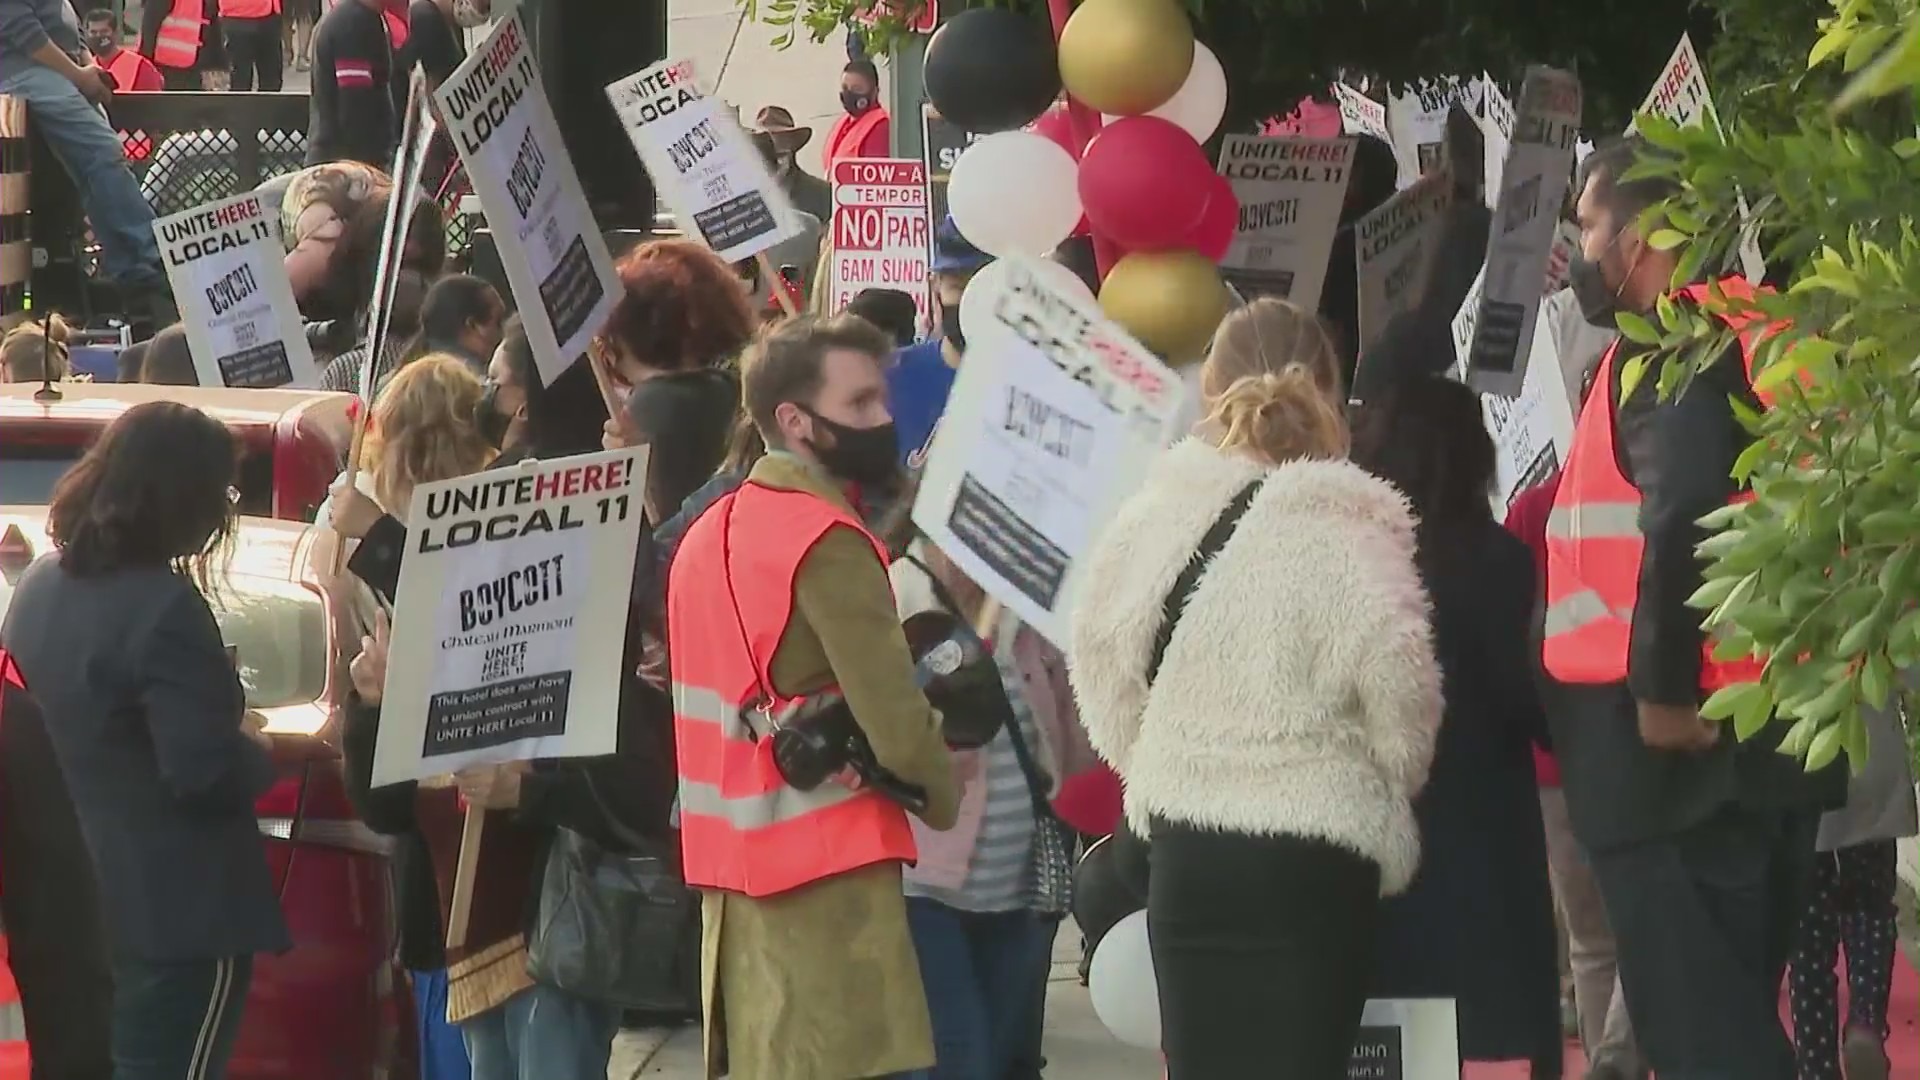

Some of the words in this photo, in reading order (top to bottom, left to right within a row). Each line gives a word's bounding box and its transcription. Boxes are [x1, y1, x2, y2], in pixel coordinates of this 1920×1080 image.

[447, 18, 522, 120] UNITEHERE!
[461, 77, 522, 155] LOCAL
[518, 55, 535, 88] 11
[1687, 75, 1702, 106] 11
[1231, 141, 1349, 163] UNITEHERE!
[1226, 163, 1316, 182] LOCAL
[1324, 168, 1343, 184] 11
[855, 189, 923, 202] TEMPOR
[162, 197, 263, 243] UNITEHERE!
[841, 209, 881, 247] NO
[887, 217, 926, 248] PAR
[1238, 199, 1300, 232] BOYCOTT
[169, 229, 250, 266] LOCAL
[251, 220, 269, 241] 11
[841, 259, 875, 283] 6AM
[205, 263, 258, 316] BOYCOTT
[426, 457, 634, 520] UNITEHERE!
[418, 504, 584, 554] LOCAL
[597, 494, 630, 524] 11
[459, 554, 564, 632] BOYCOTT
[482, 654, 525, 674] HERE!
[485, 641, 528, 661] UNITE
[436, 695, 459, 708] This
[462, 689, 489, 704] hotel
[491, 685, 515, 698] does
[518, 680, 536, 691] not
[538, 676, 565, 689] have
[481, 670, 510, 683] LOCAL
[452, 709, 483, 722] union
[485, 700, 527, 717] contract
[531, 693, 553, 706] with
[436, 726, 474, 742] UNITE
[476, 719, 506, 735] HERE
[508, 713, 536, 728] Local
[541, 710, 553, 722] 11
